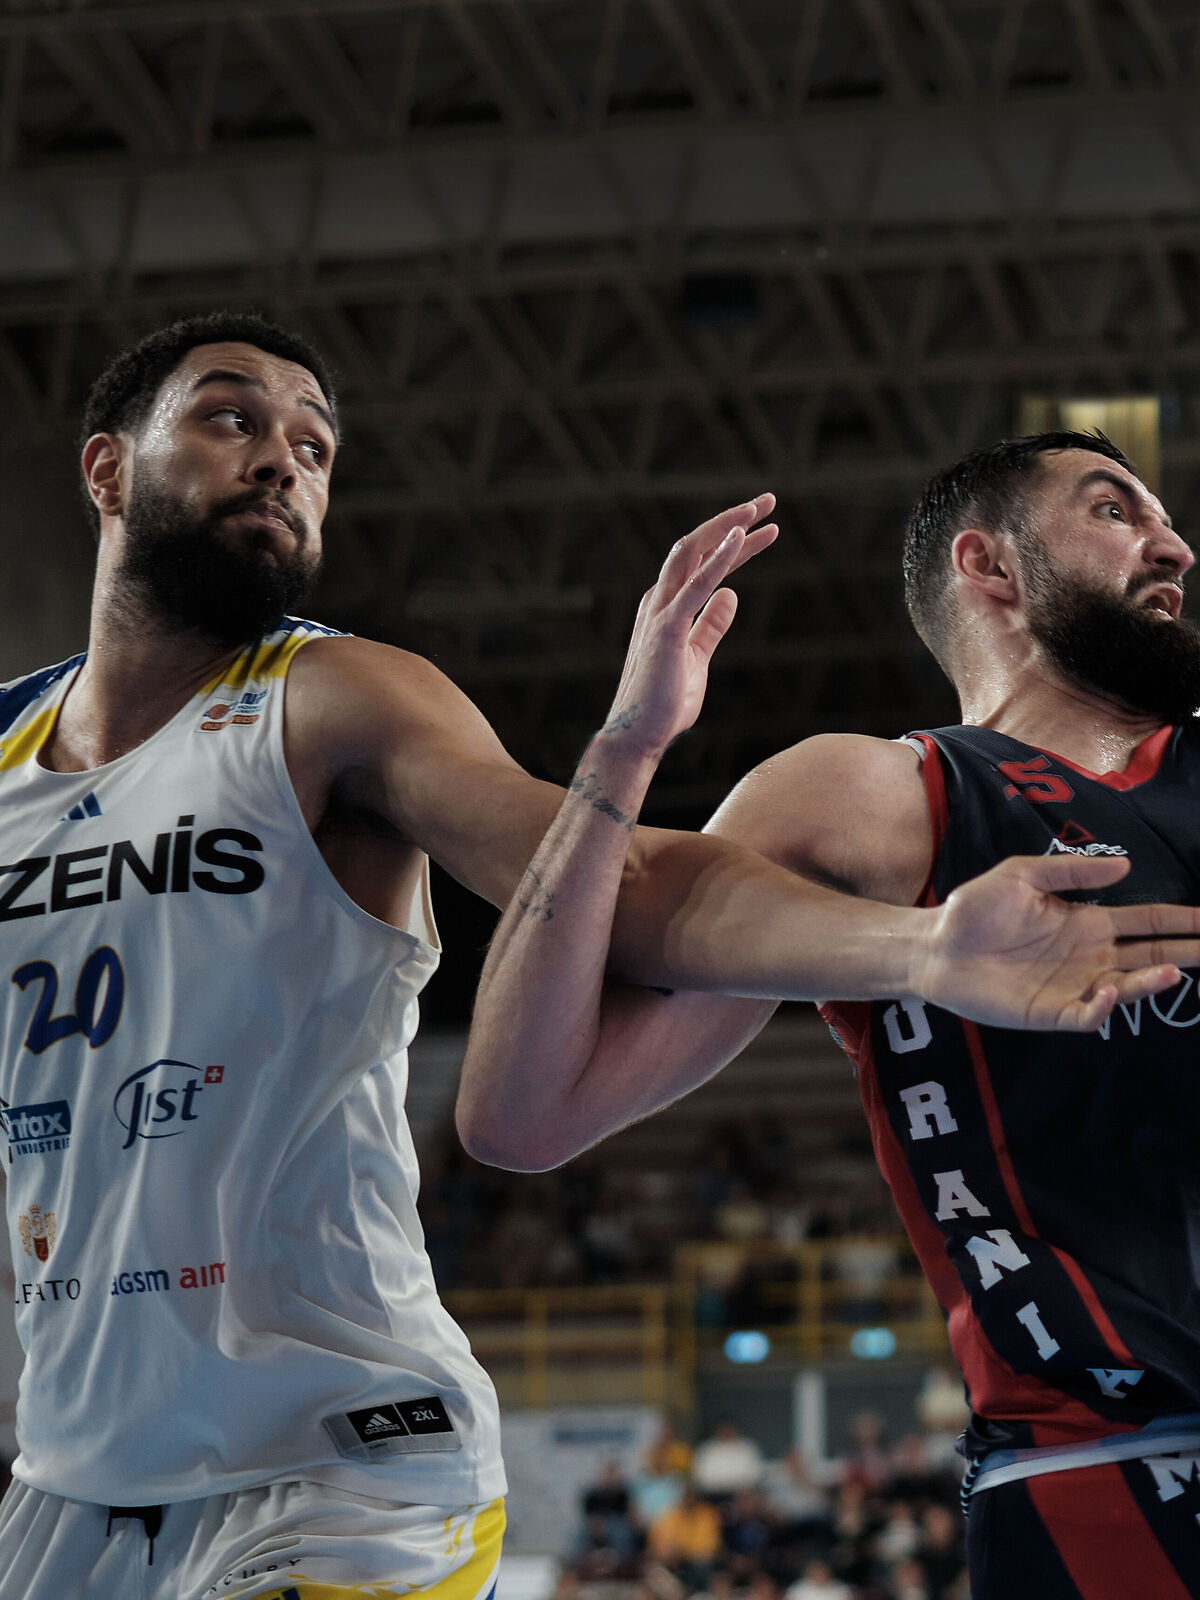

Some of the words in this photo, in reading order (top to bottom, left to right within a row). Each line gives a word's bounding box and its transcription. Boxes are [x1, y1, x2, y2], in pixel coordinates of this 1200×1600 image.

[11, 945, 125, 1055] 20
[412, 1409, 439, 1421] 2XL
[364, 1423, 400, 1435] adidas
